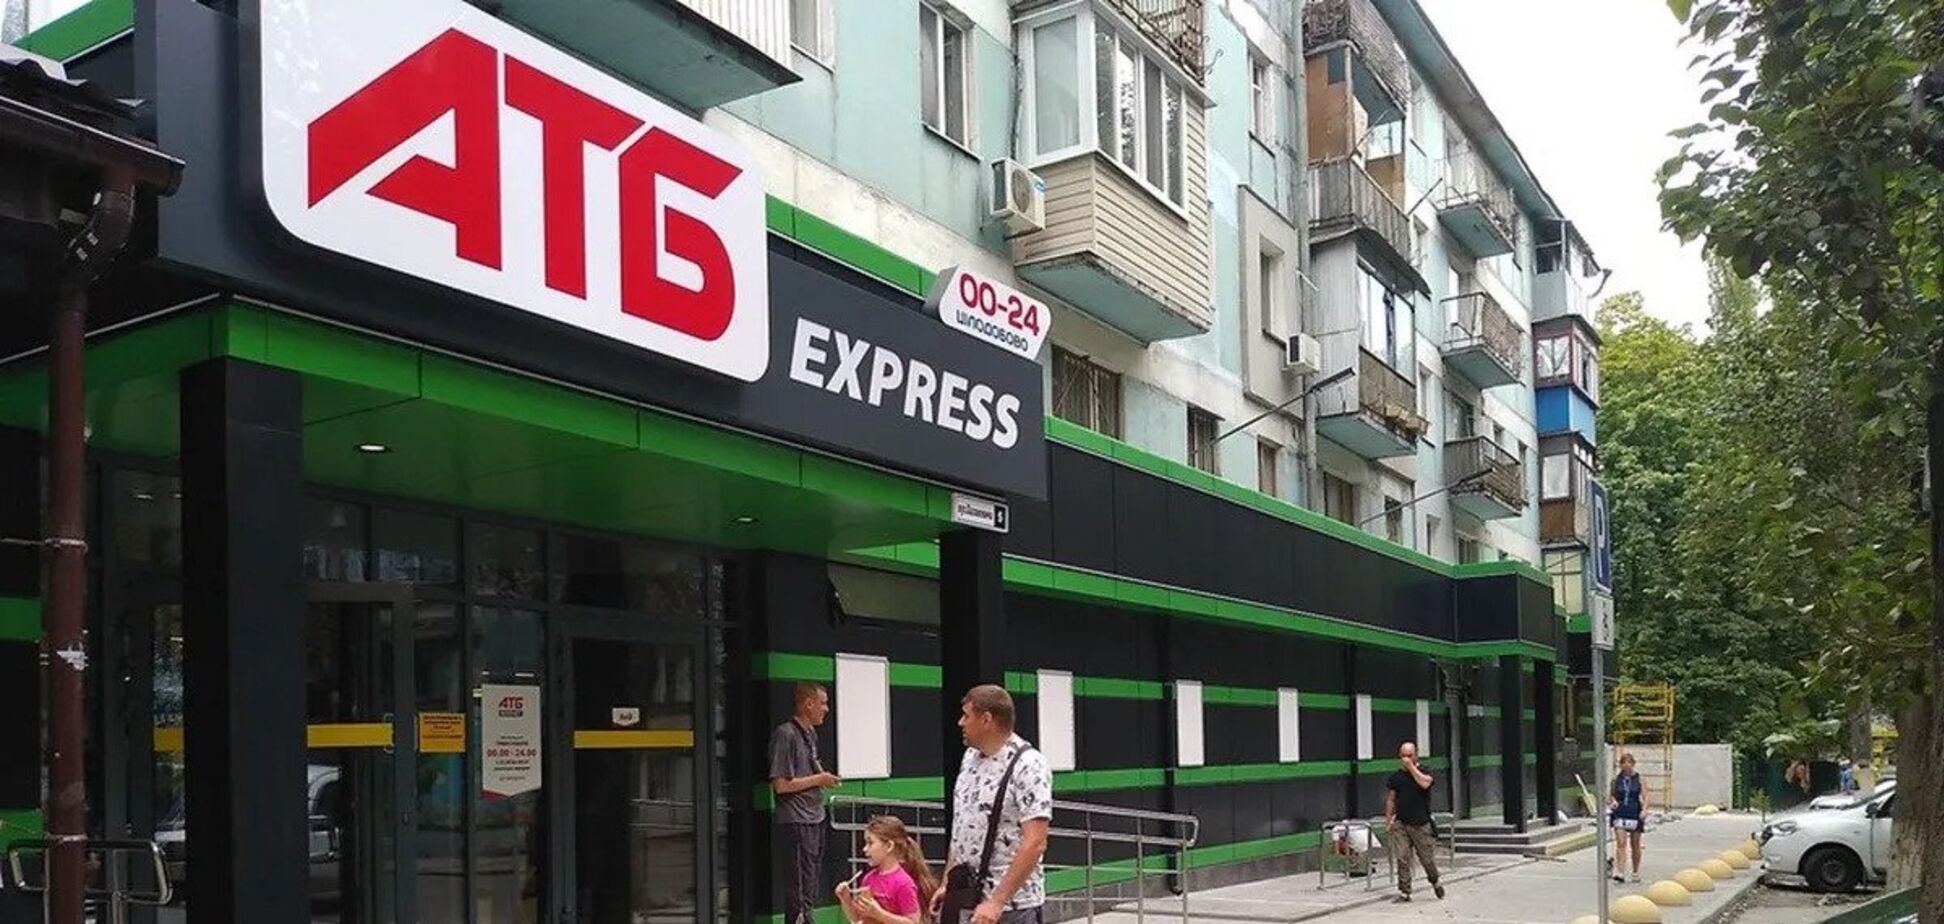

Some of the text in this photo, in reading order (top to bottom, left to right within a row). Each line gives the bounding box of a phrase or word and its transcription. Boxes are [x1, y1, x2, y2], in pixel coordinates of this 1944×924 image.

[308, 27, 743, 342] АТБ
[956, 309, 1028, 352] ЦІЛОДОБОВО
[960, 273, 1040, 336] 00-24
[789, 316, 1021, 449] EXPRESS
[1595, 493, 1606, 578] P
